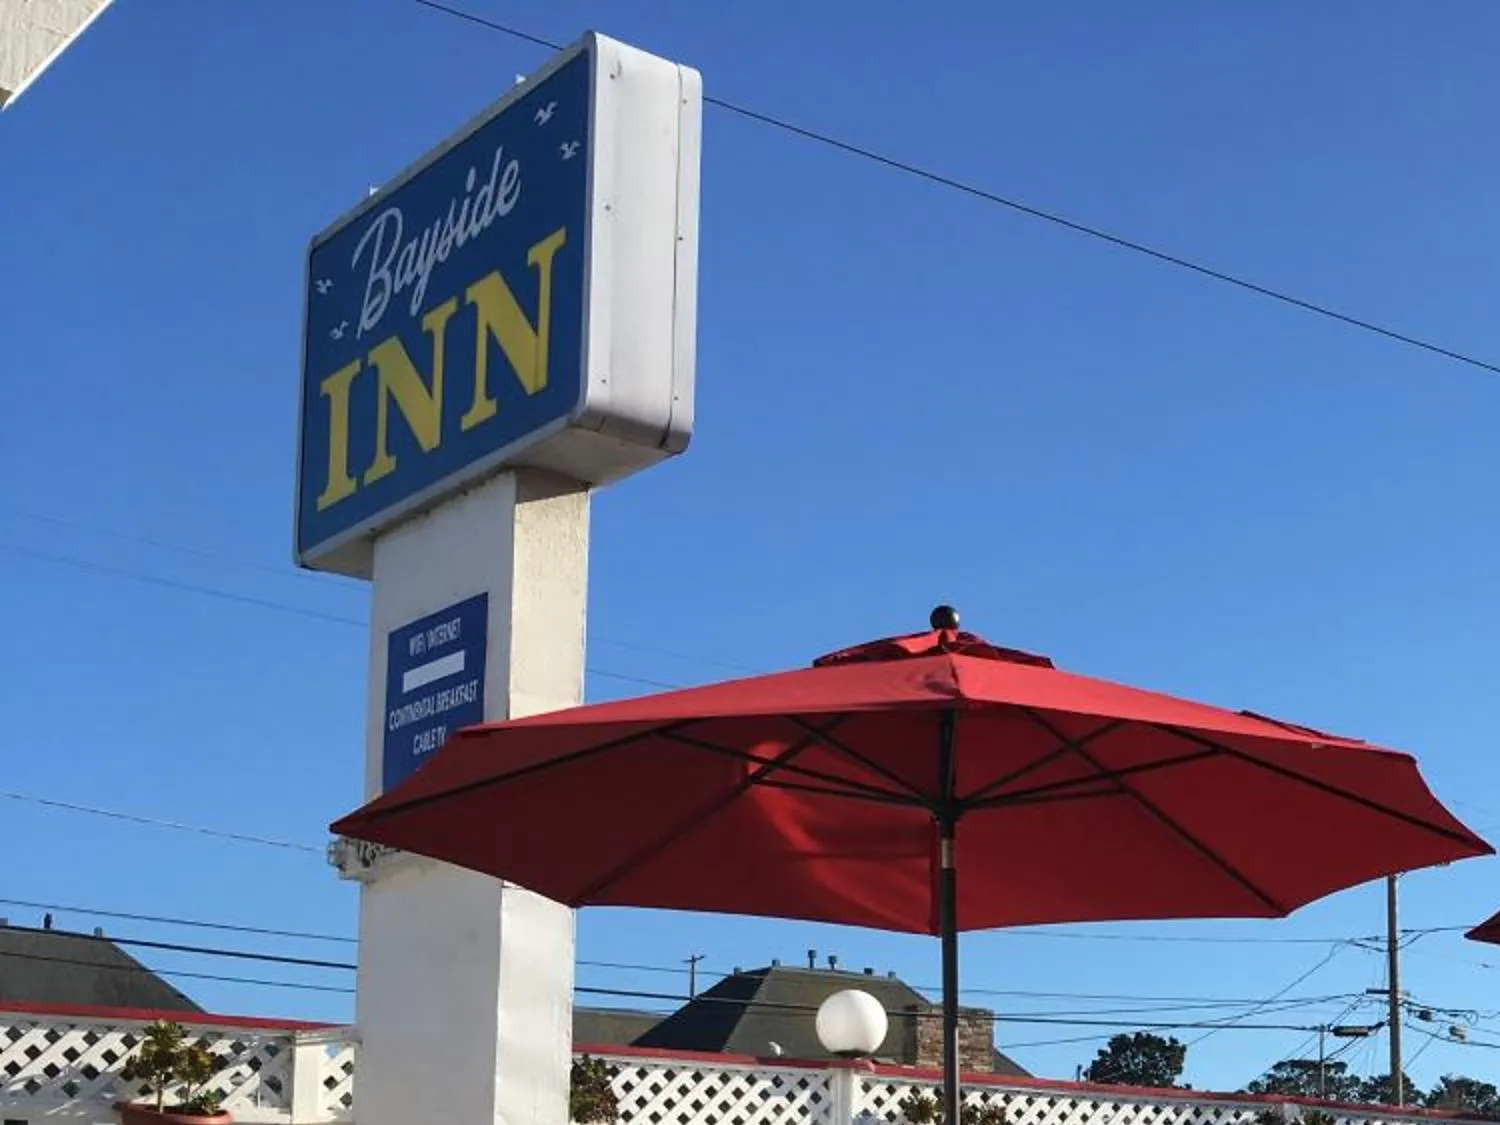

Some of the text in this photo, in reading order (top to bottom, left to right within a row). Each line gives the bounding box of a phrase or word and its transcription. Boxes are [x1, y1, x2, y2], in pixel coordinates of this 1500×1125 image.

[351, 145, 522, 339] Bayside
[316, 226, 567, 512] INN
[427, 616, 461, 651] INTERNET
[389, 680, 478, 731] CONTINENTAL BREAKFAST
[413, 728, 436, 755] CABLE
